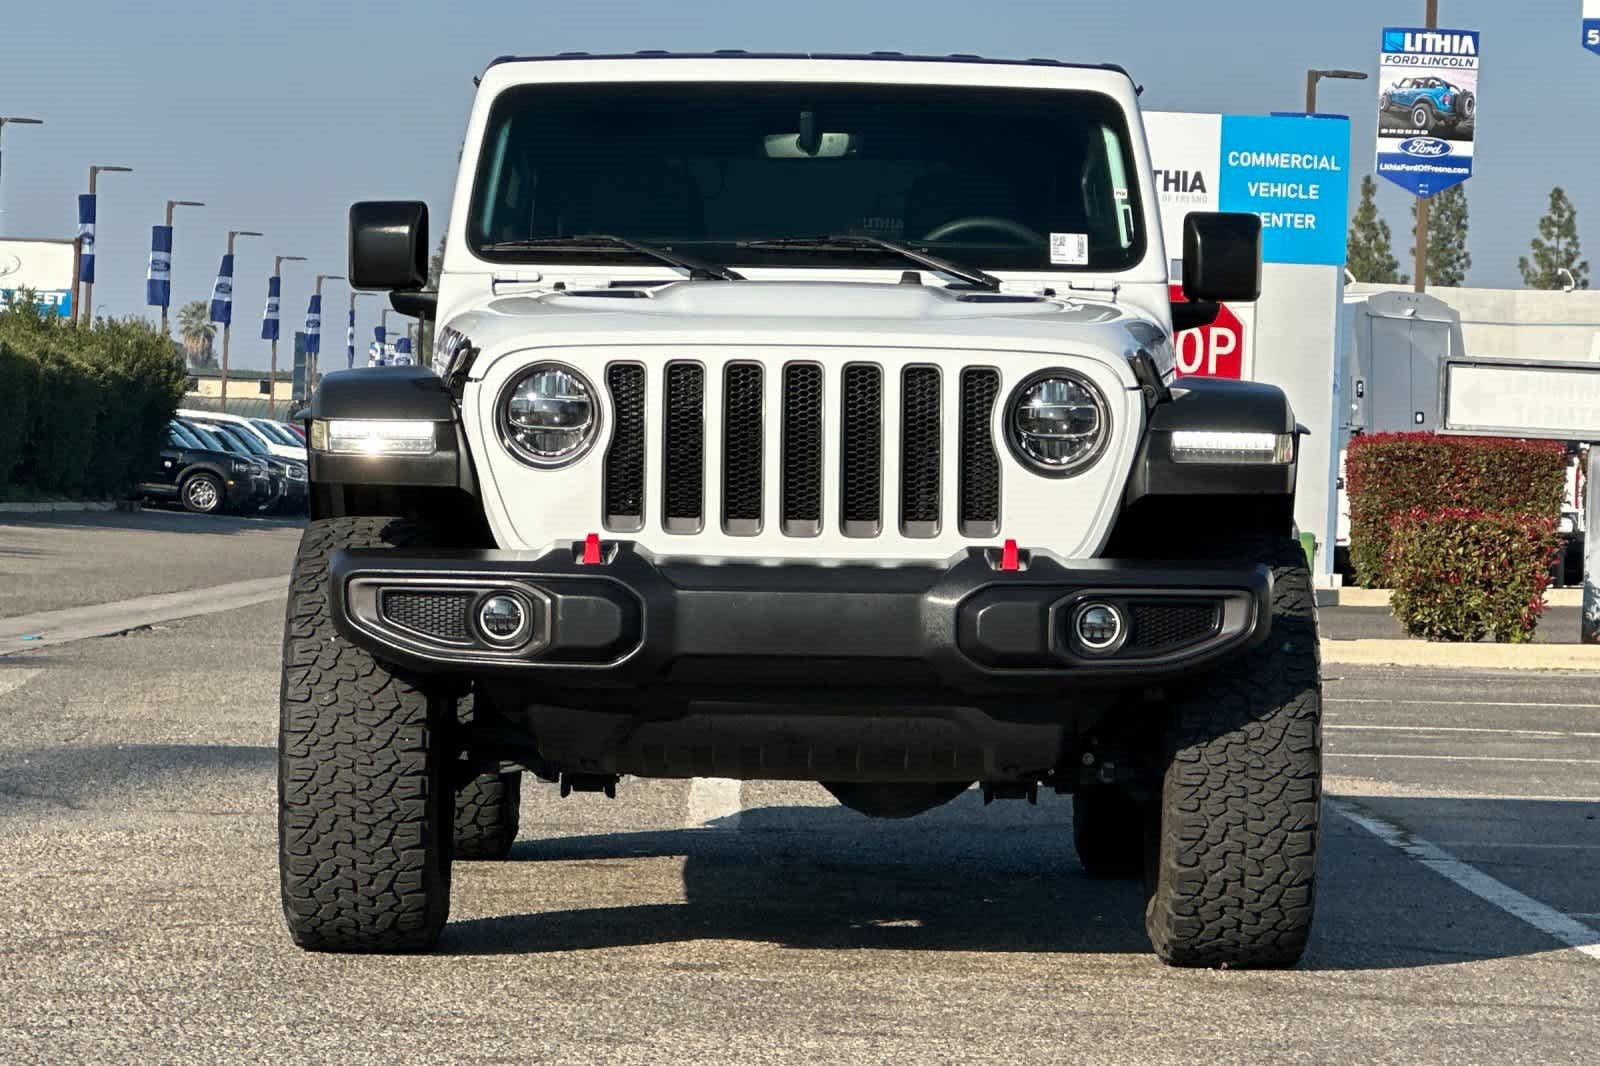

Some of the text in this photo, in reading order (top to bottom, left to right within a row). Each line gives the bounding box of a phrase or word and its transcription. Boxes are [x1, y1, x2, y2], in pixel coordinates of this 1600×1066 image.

[1403, 32, 1476, 55] LITHIA
[1385, 55, 1474, 67] FORD LINCOLN
[1409, 140, 1444, 154] Ford
[1228, 150, 1341, 171] COMMERCIAL
[1247, 182, 1320, 200] VEHICLE
[1252, 211, 1316, 229] ENTER
